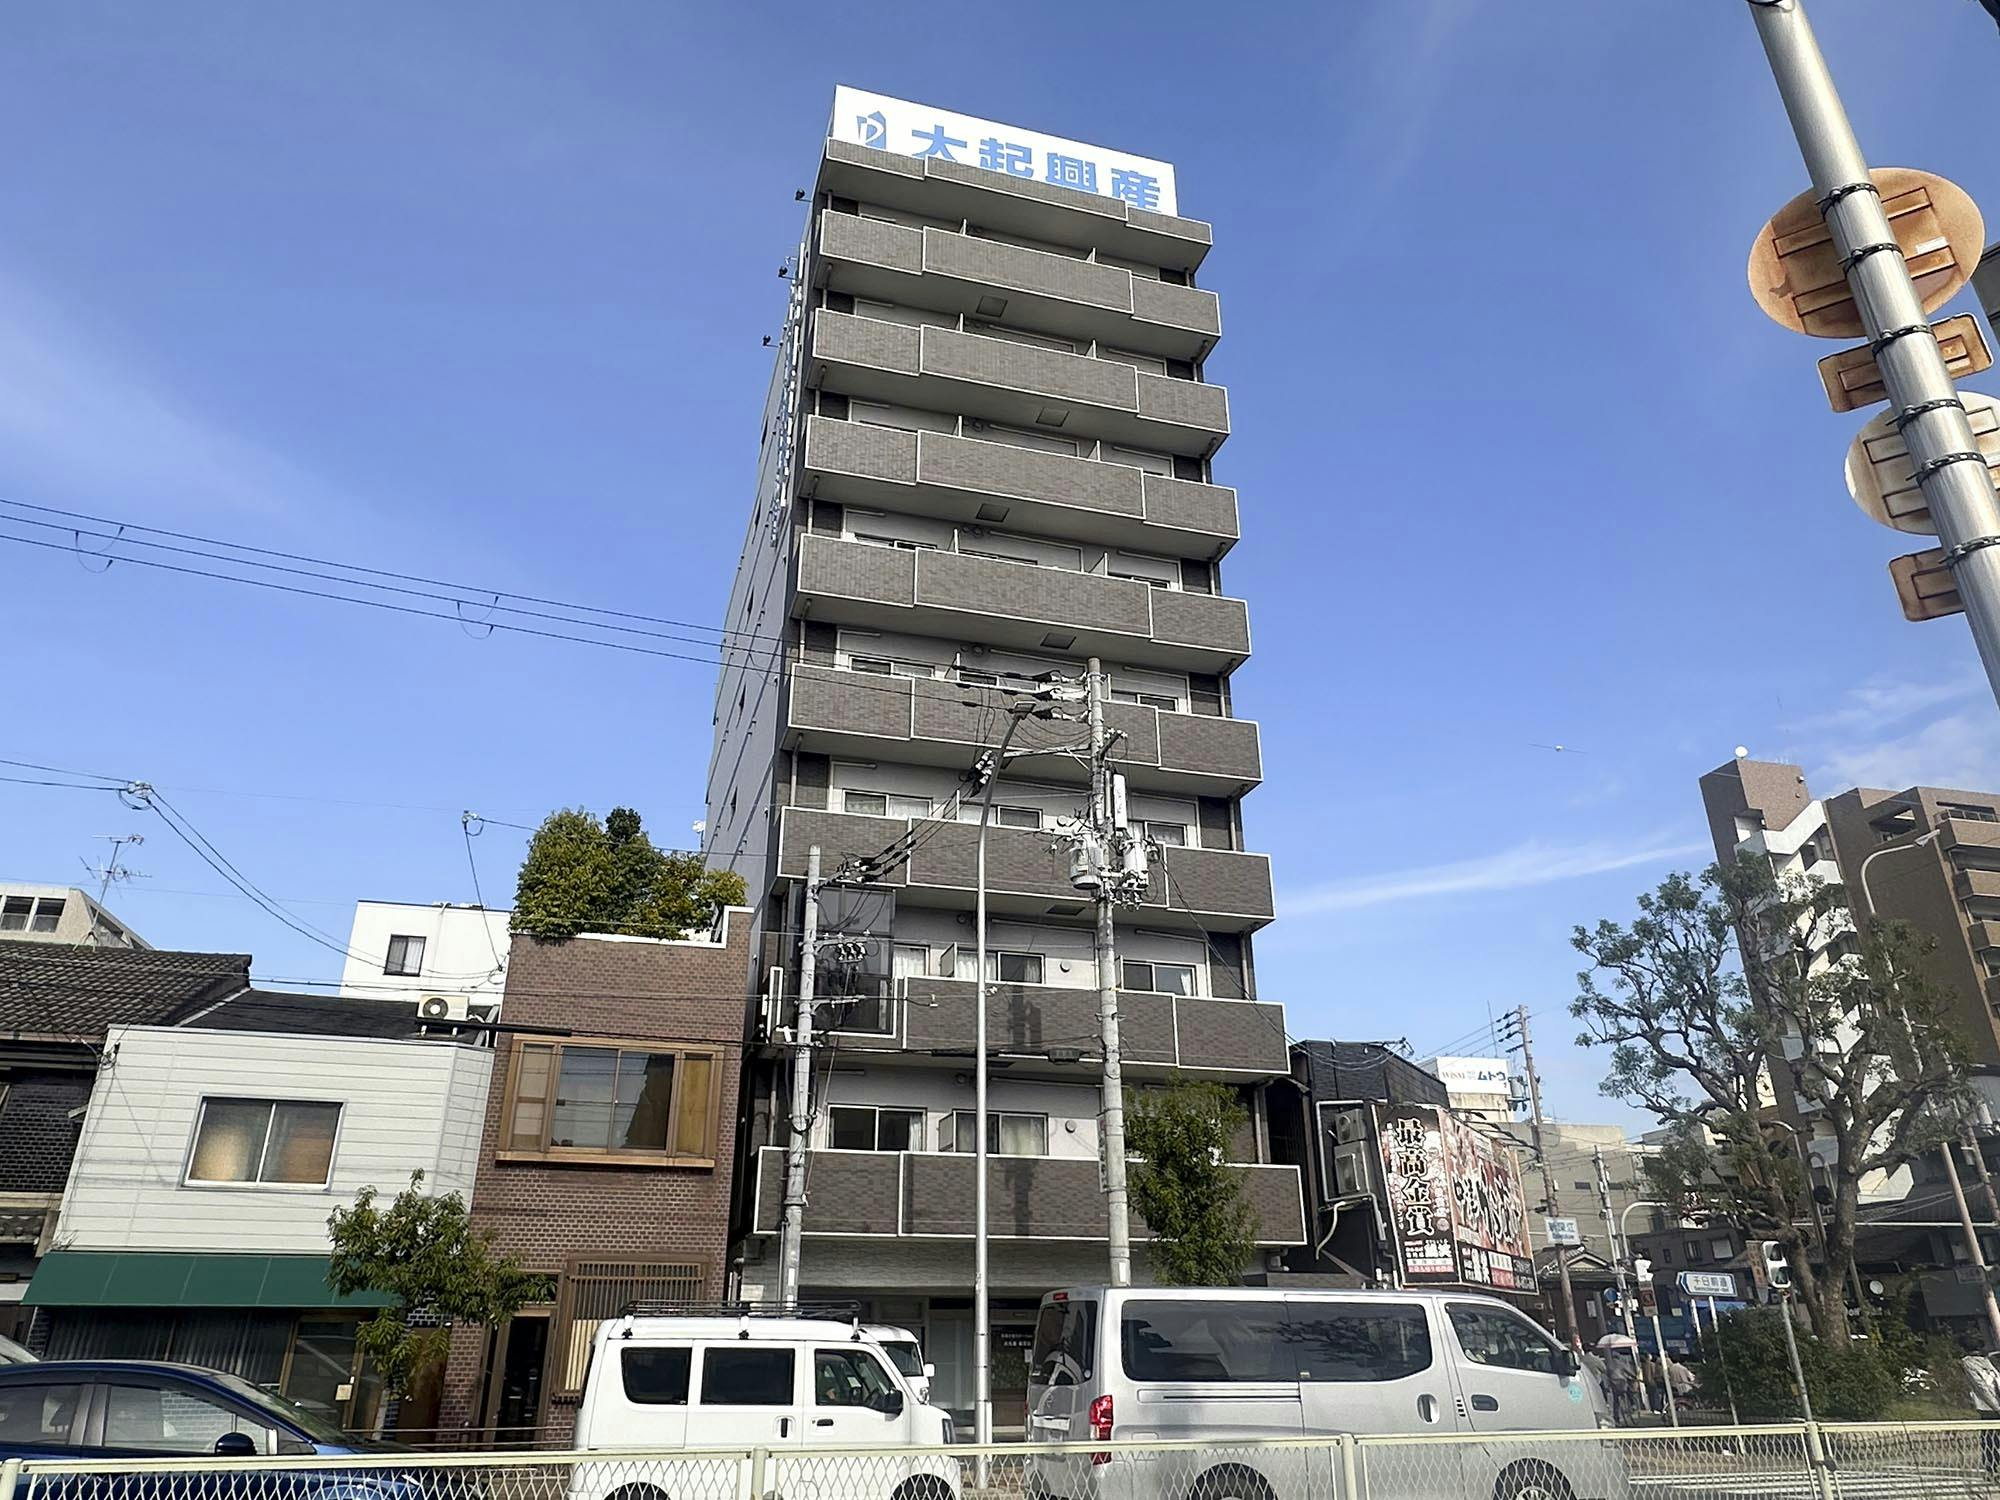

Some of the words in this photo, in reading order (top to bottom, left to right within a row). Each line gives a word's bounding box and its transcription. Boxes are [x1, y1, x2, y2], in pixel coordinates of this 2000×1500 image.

[911, 124, 1160, 209] 大起興産
[1396, 1118, 1435, 1236] 最高金賞
